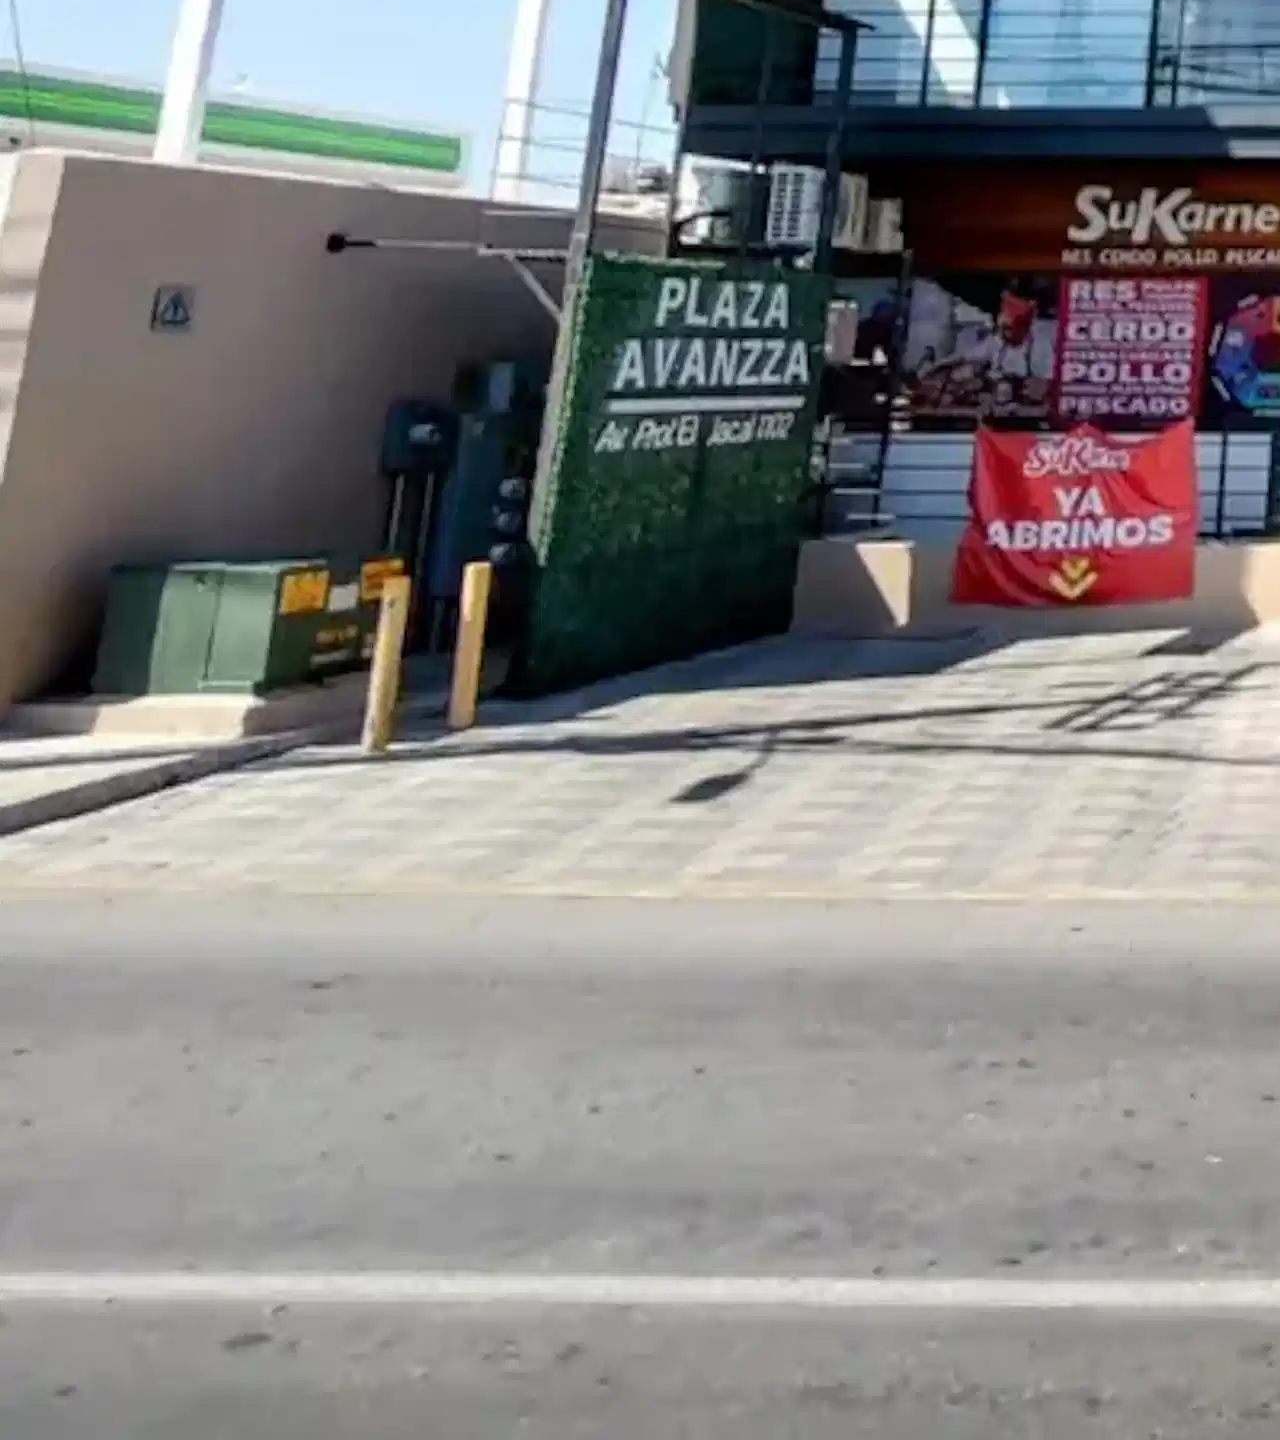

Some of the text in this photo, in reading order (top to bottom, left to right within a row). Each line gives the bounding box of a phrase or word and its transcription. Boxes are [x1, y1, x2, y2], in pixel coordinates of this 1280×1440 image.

[654, 276, 790, 329] PLAZA
[1069, 280, 1137, 301] RES
[1066, 320, 1196, 342] CERDO
[613, 337, 810, 390] AVANZZA
[1060, 362, 1193, 384] POLLO
[1058, 395, 1191, 416] PESCADO
[1052, 485, 1105, 517] YA
[986, 514, 1175, 551] ABRIMOS
